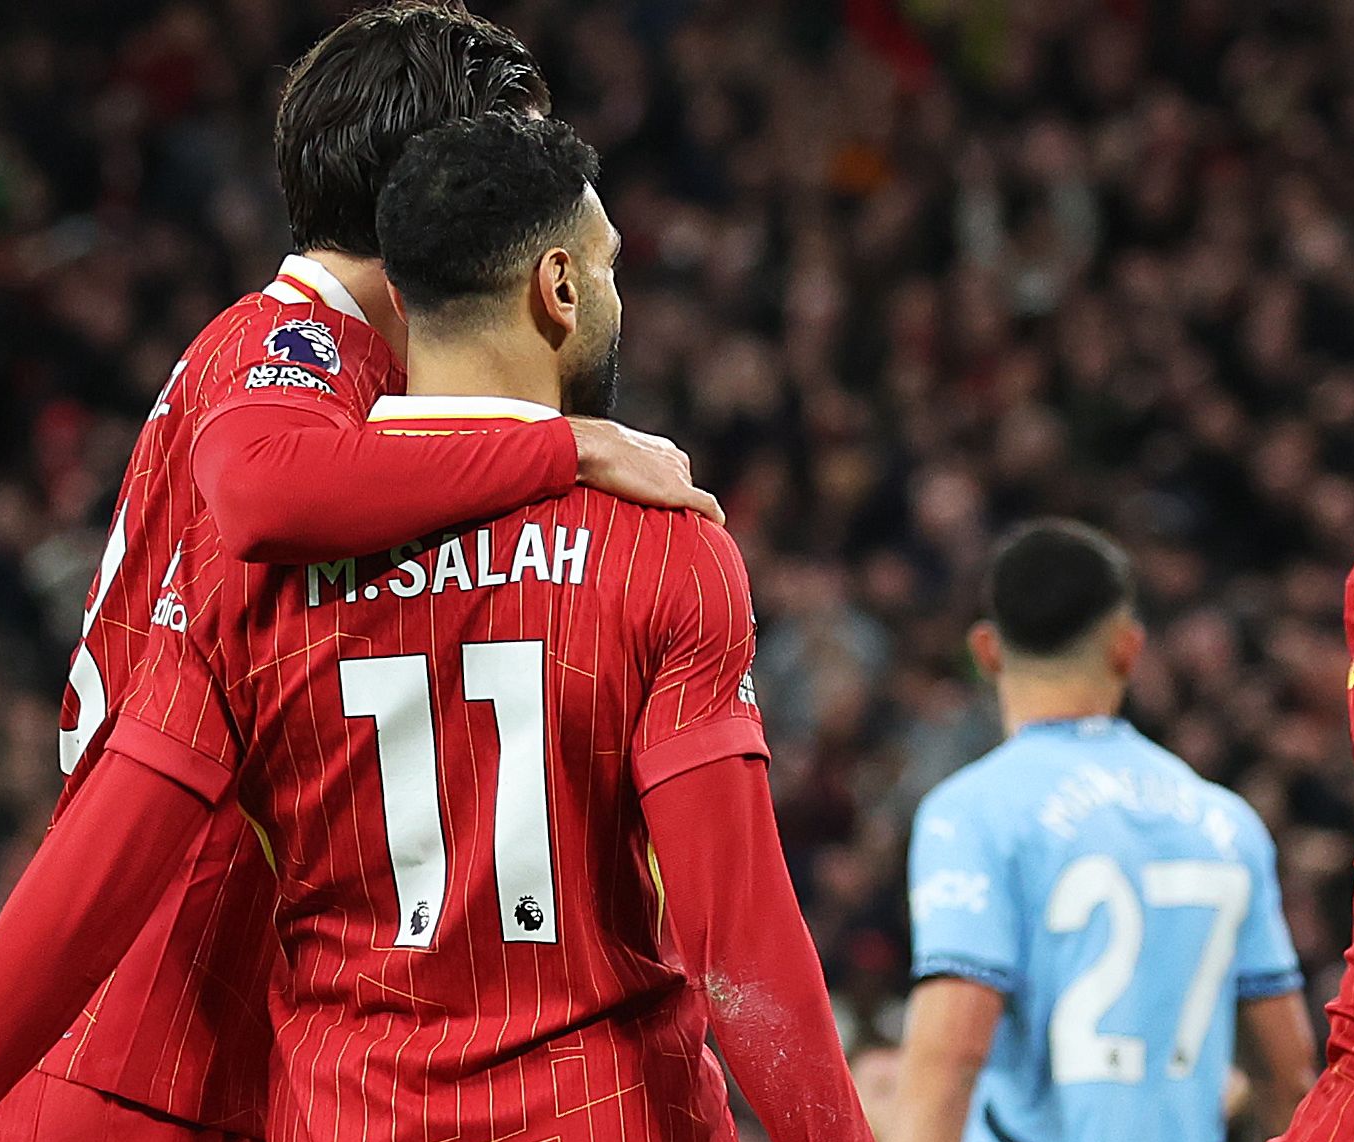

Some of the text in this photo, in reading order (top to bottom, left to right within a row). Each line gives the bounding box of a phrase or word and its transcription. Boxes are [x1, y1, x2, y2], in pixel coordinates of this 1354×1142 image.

[248, 366, 278, 378] No
[307, 522, 591, 608] M.SALAH
[338, 639, 558, 948] 11
[1048, 855, 1252, 1086] 27
